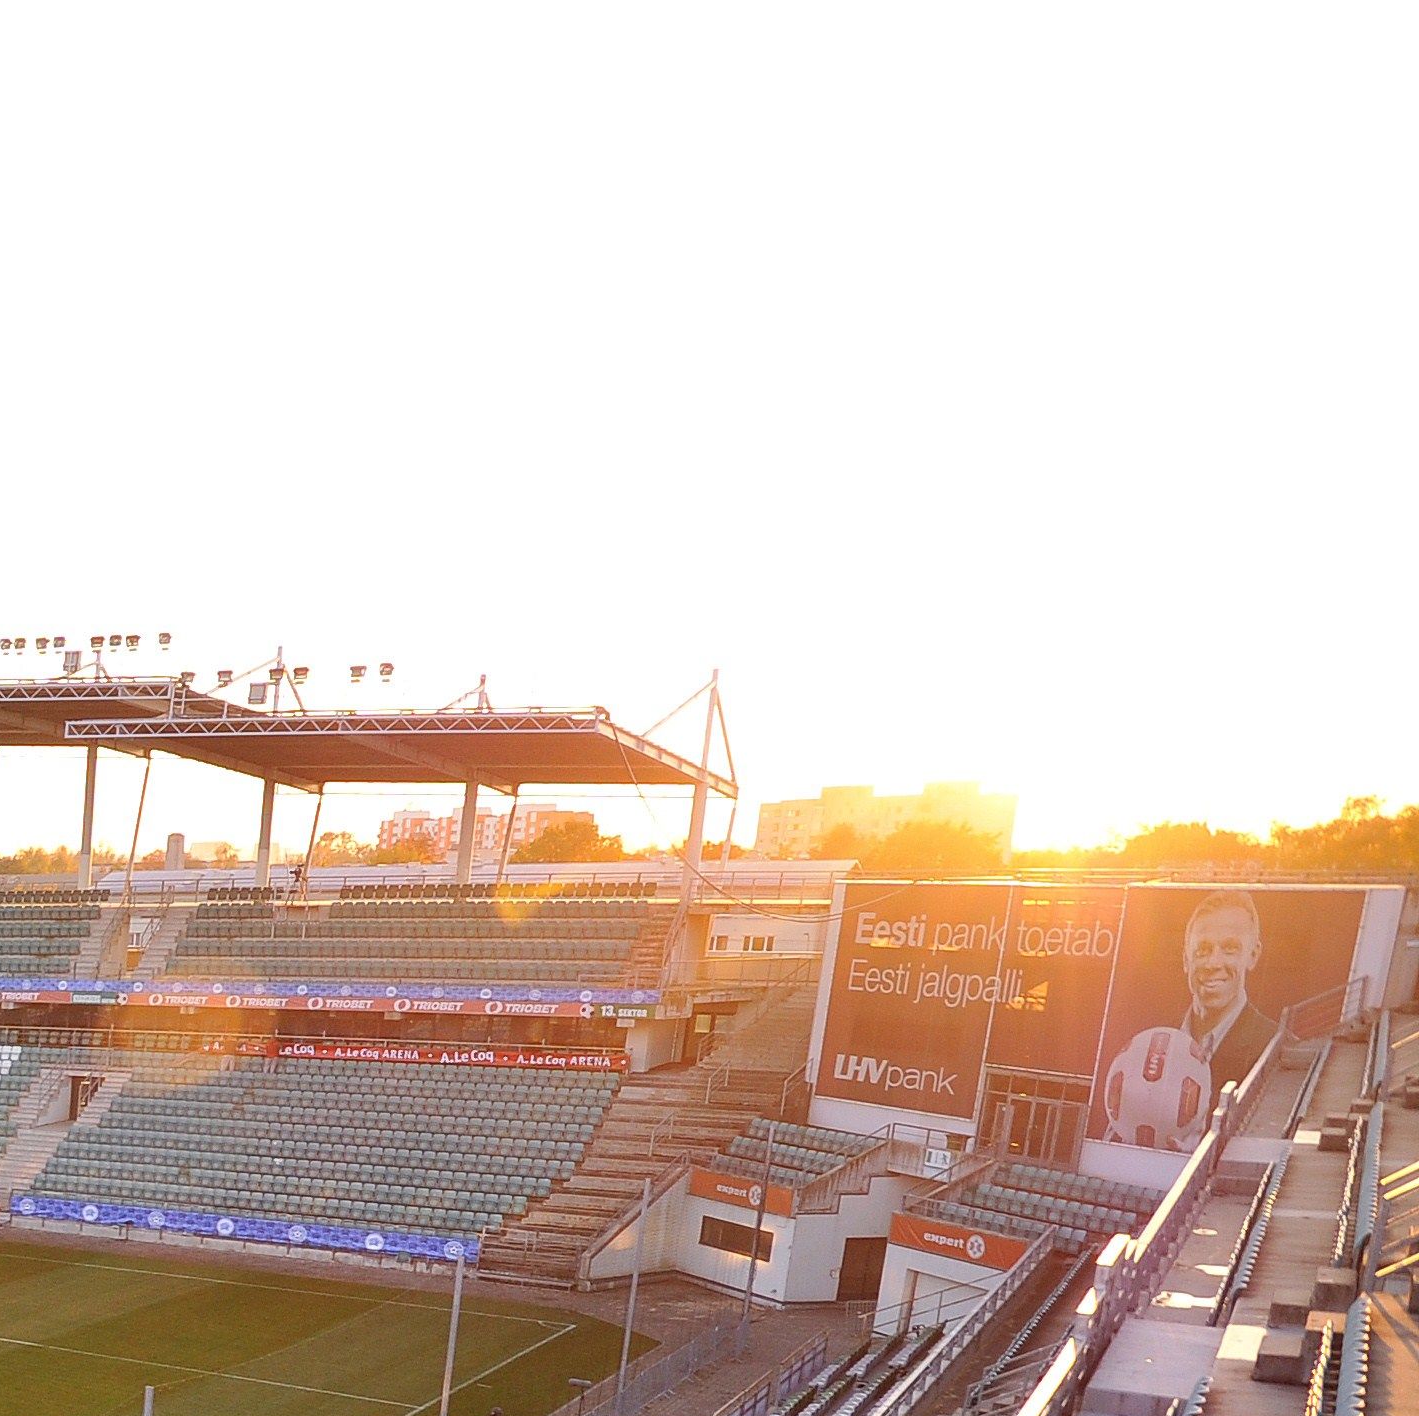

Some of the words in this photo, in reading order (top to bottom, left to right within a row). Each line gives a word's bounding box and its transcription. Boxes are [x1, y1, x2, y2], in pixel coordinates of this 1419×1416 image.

[855, 911, 927, 947] Eesti
[933, 916, 1005, 956] pank
[1017, 920, 1114, 957] toetab
[848, 959, 912, 994] Eesti
[165, 996, 208, 1005] TRIOBET
[242, 998, 288, 1007] TRIOBET
[325, 999, 374, 1009] TRIOBET
[413, 1001, 464, 1011] TRIOBET
[505, 1004, 559, 1014] TRIOBET
[293, 1044, 314, 1055] Coq
[360, 1048, 378, 1059] Coq
[382, 1050, 419, 1060] ARENA
[441, 1052, 469, 1064] A.Le
[471, 1050, 494, 1062] Coq
[545, 1056, 566, 1067] Coq
[569, 1056, 611, 1067] ARENA
[717, 1184, 747, 1198] expert
[923, 1230, 964, 1249] expert
